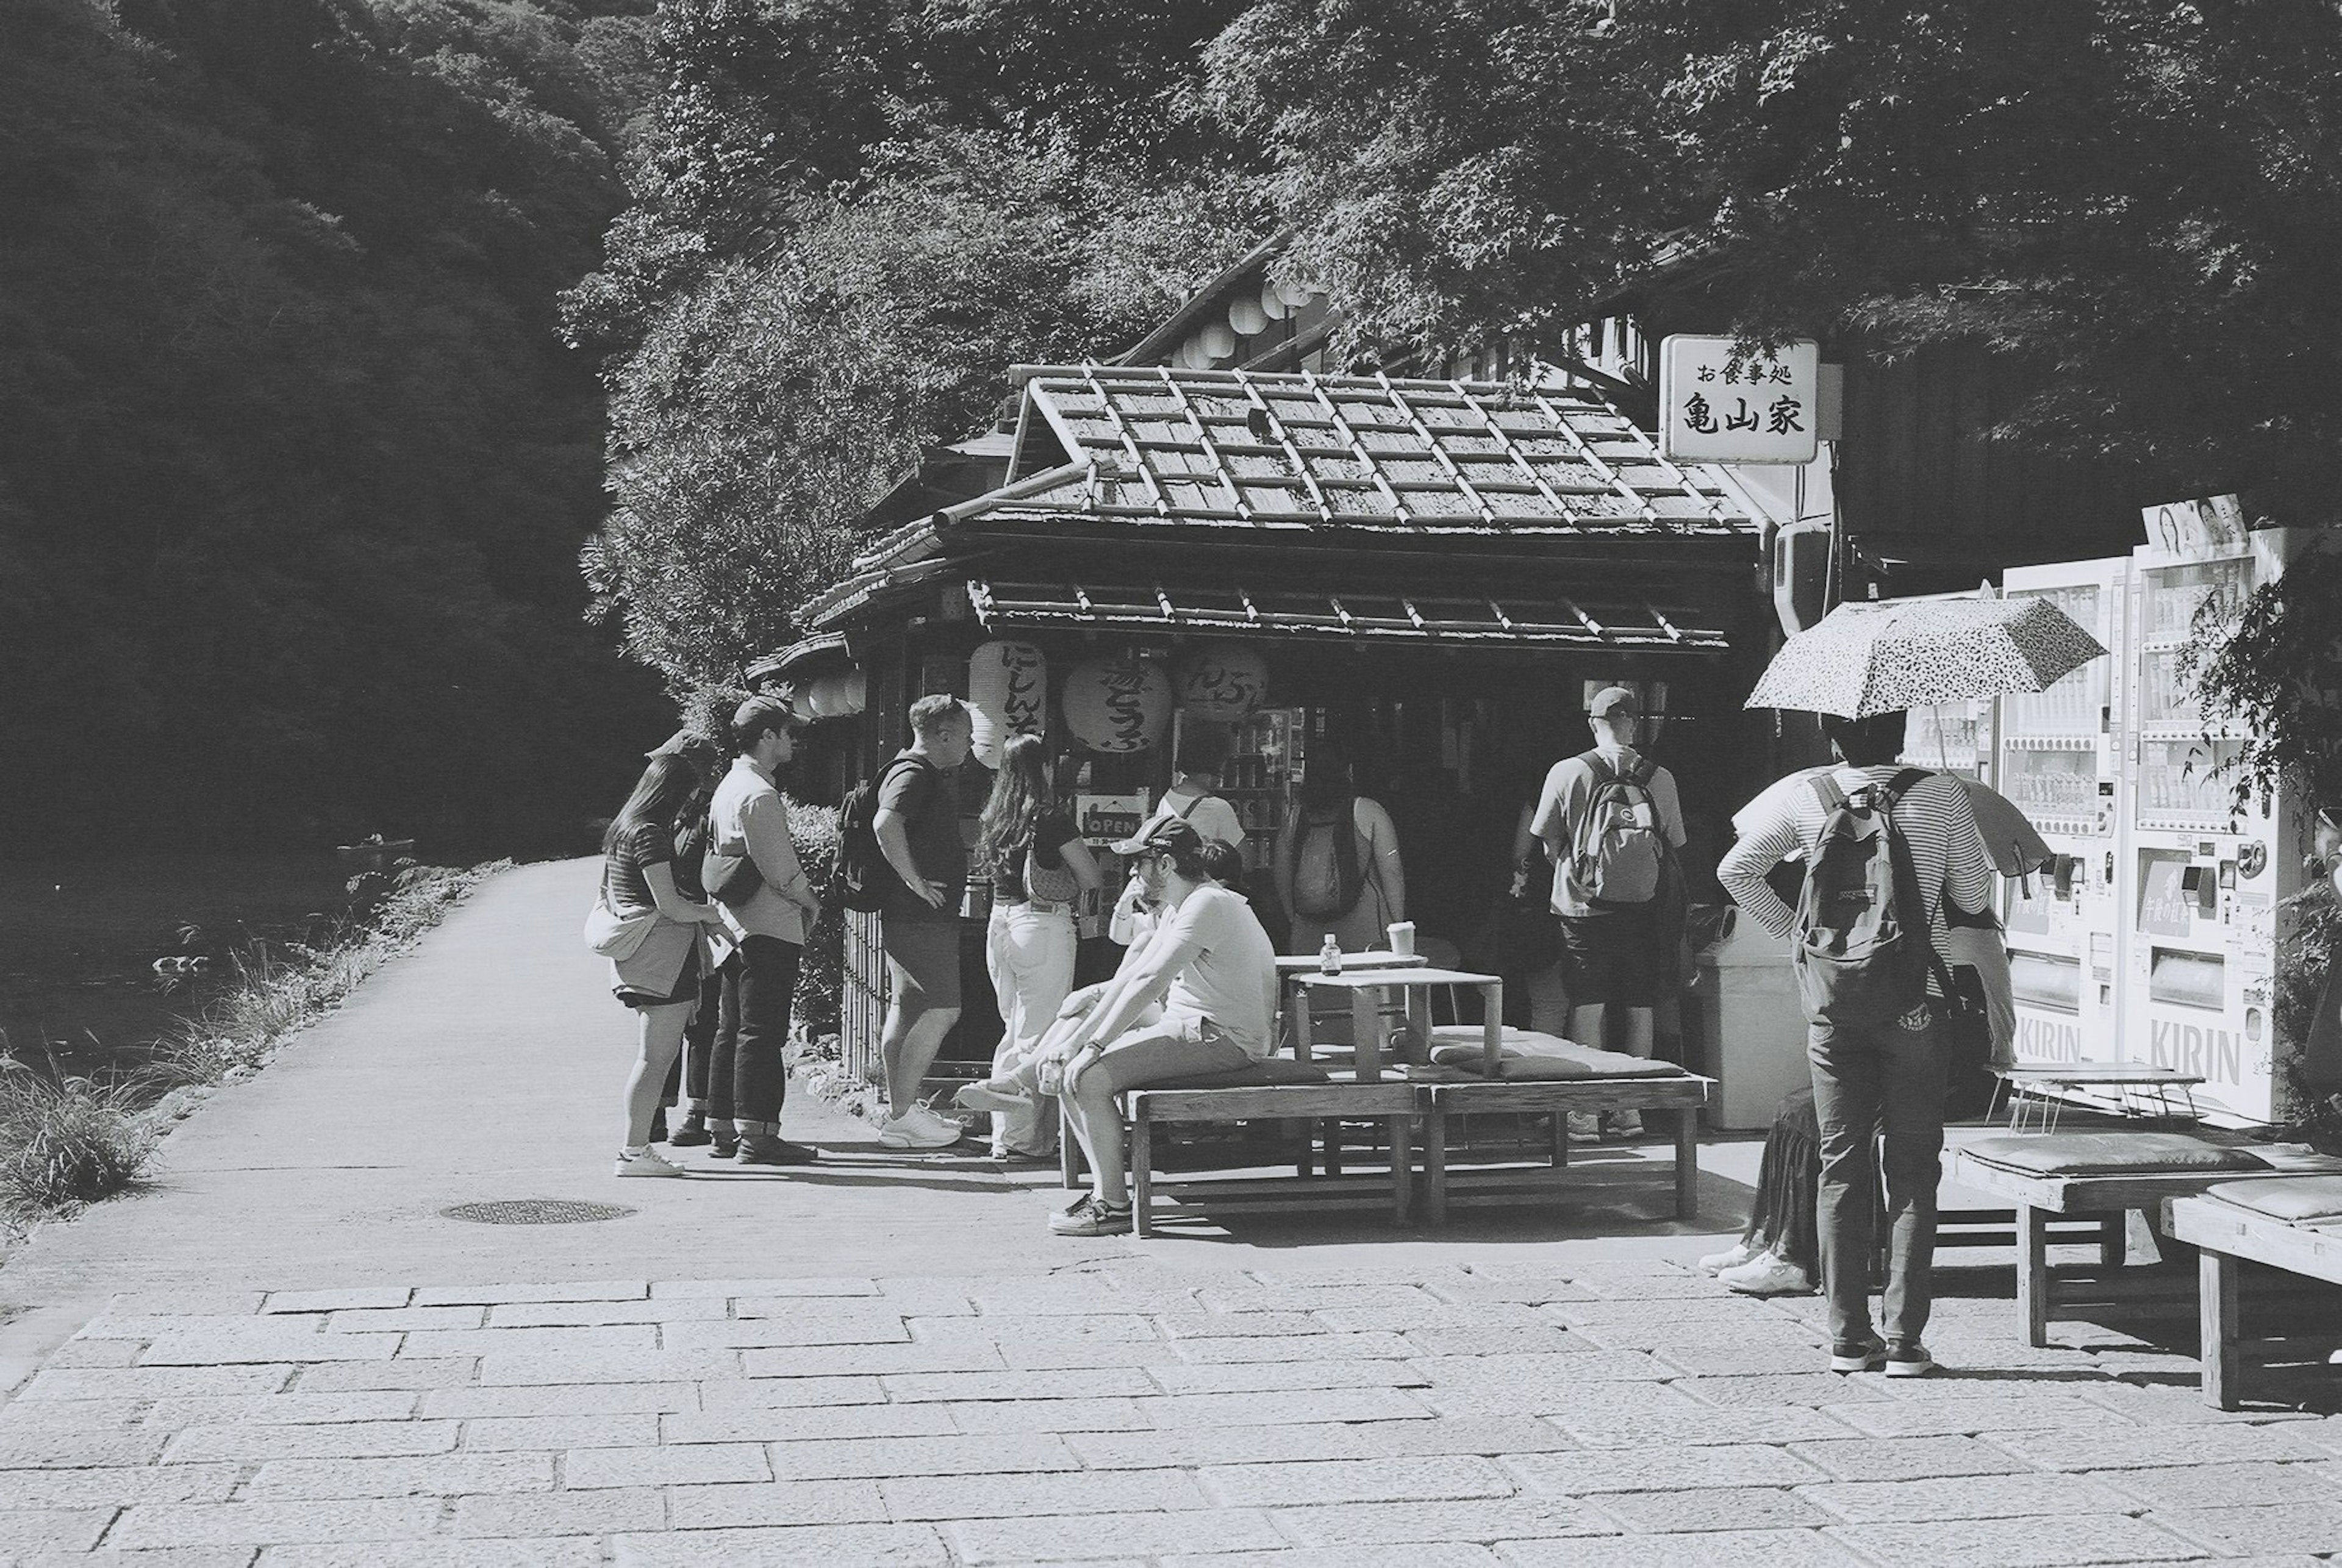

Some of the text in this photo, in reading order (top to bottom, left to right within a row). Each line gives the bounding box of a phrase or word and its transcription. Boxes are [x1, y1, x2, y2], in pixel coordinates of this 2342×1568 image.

[1697, 360, 1792, 385] お食事処
[1683, 392, 1805, 435] 亀山家
[1089, 818, 1136, 834] OPEN
[2020, 1017, 2080, 1063] KIRIN
[2150, 1019, 2240, 1086] KIRIN
